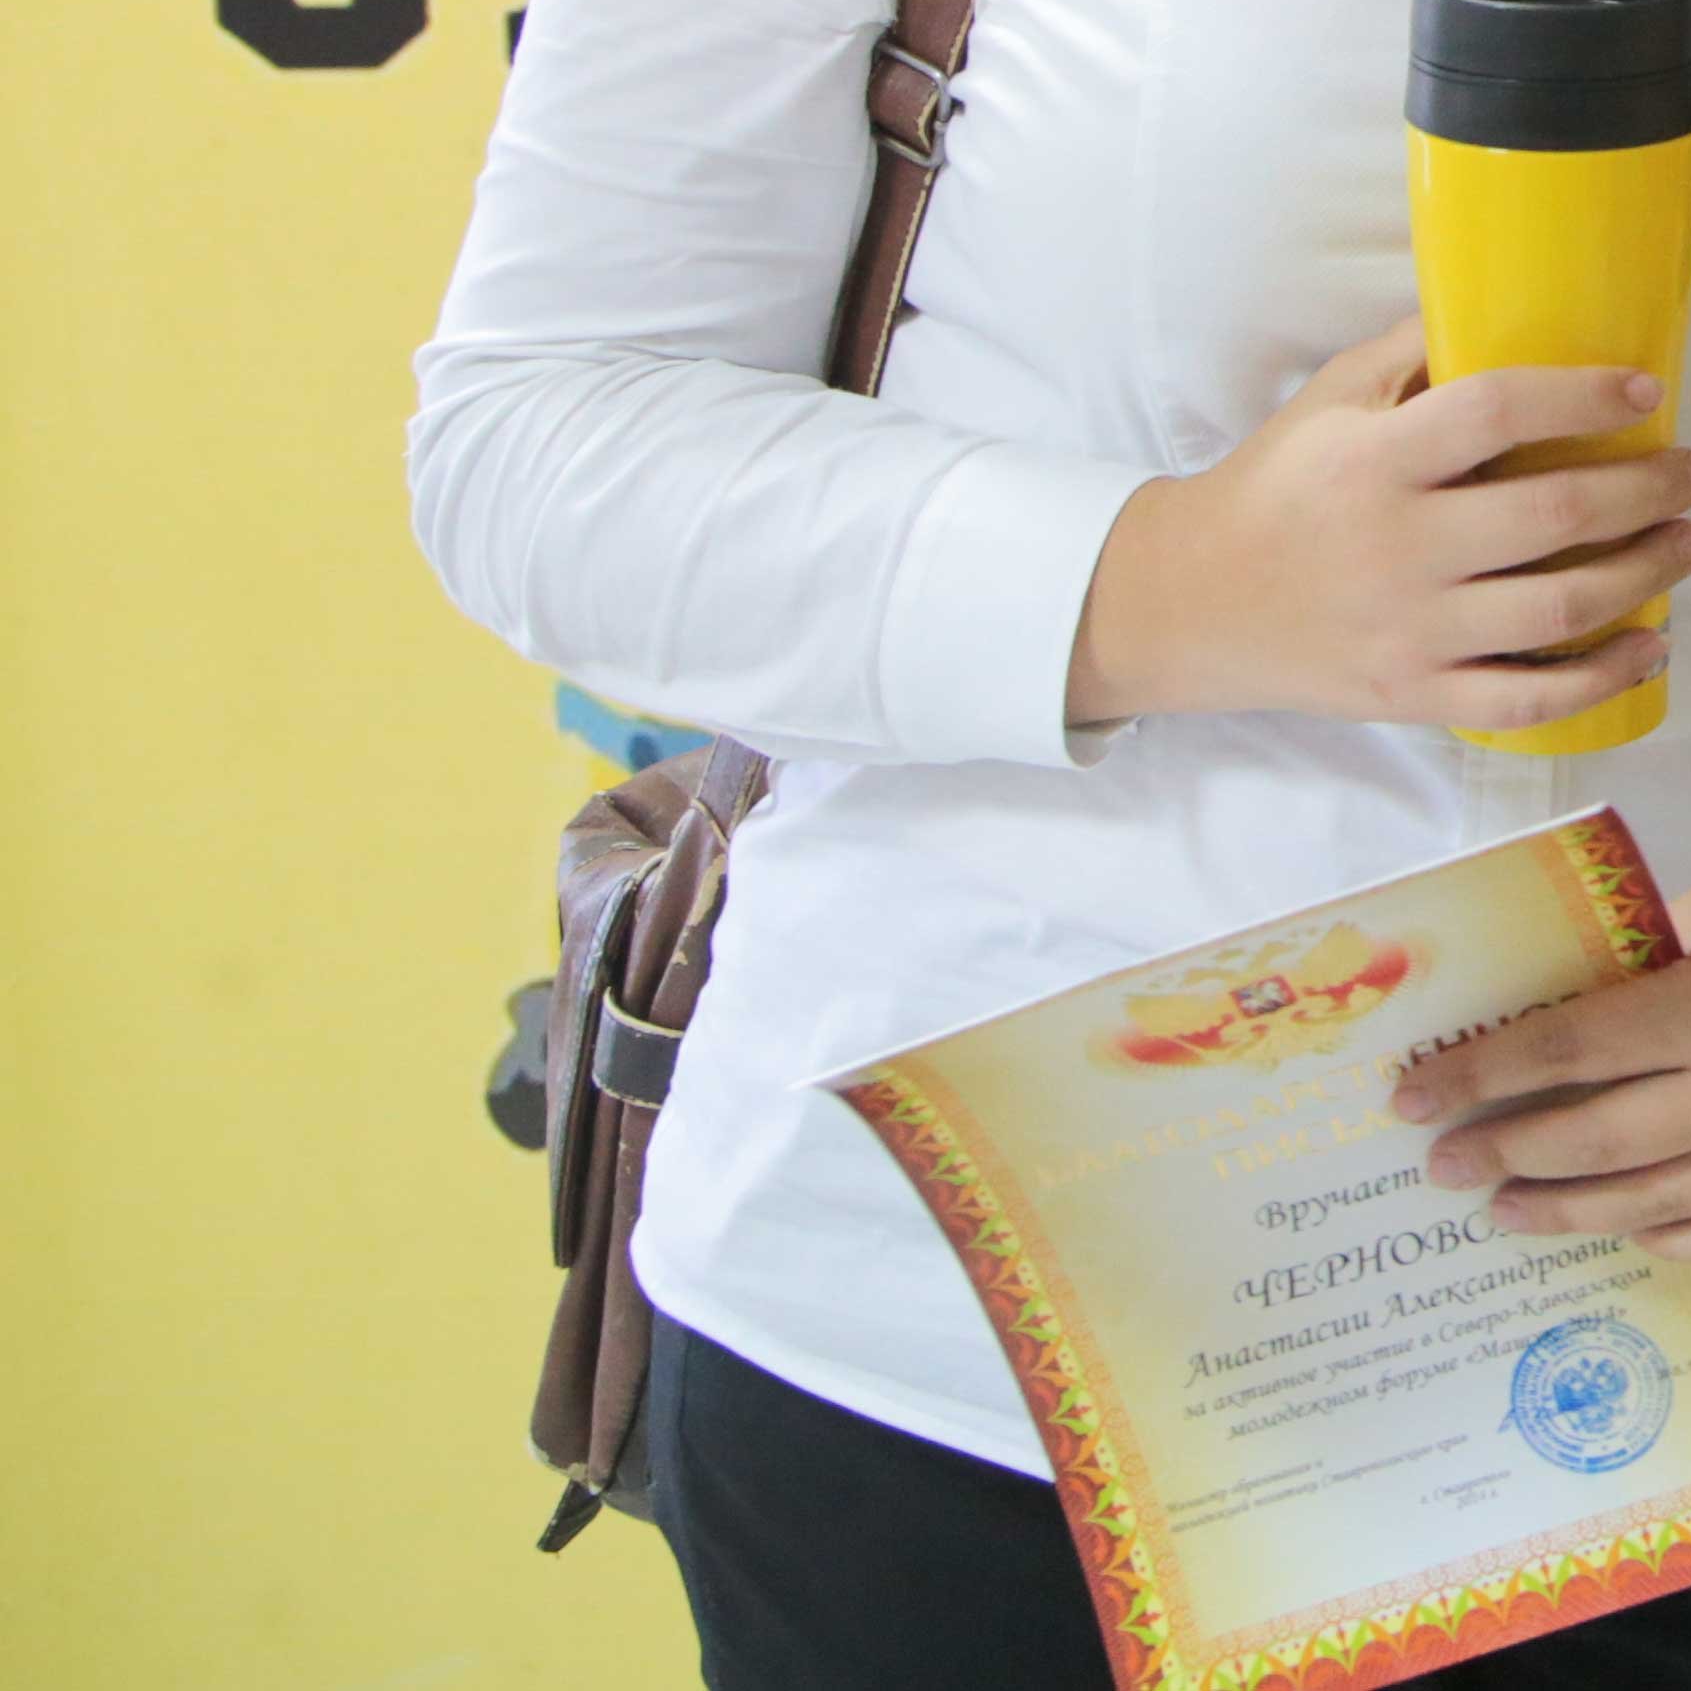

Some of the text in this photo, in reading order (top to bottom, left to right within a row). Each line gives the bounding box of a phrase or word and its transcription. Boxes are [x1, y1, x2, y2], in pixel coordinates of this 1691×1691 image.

[1256, 1165, 1422, 1233] Вручает
[1233, 1209, 1510, 1309] ЧЕРНОВО
[1182, 1235, 1625, 1389] Анастасии Александровне
[1212, 1367, 1318, 1412] активное
[1324, 1338, 1415, 1385] участие
[1227, 1385, 1370, 1441] молодежном
[1375, 1356, 1459, 1402] форуме
